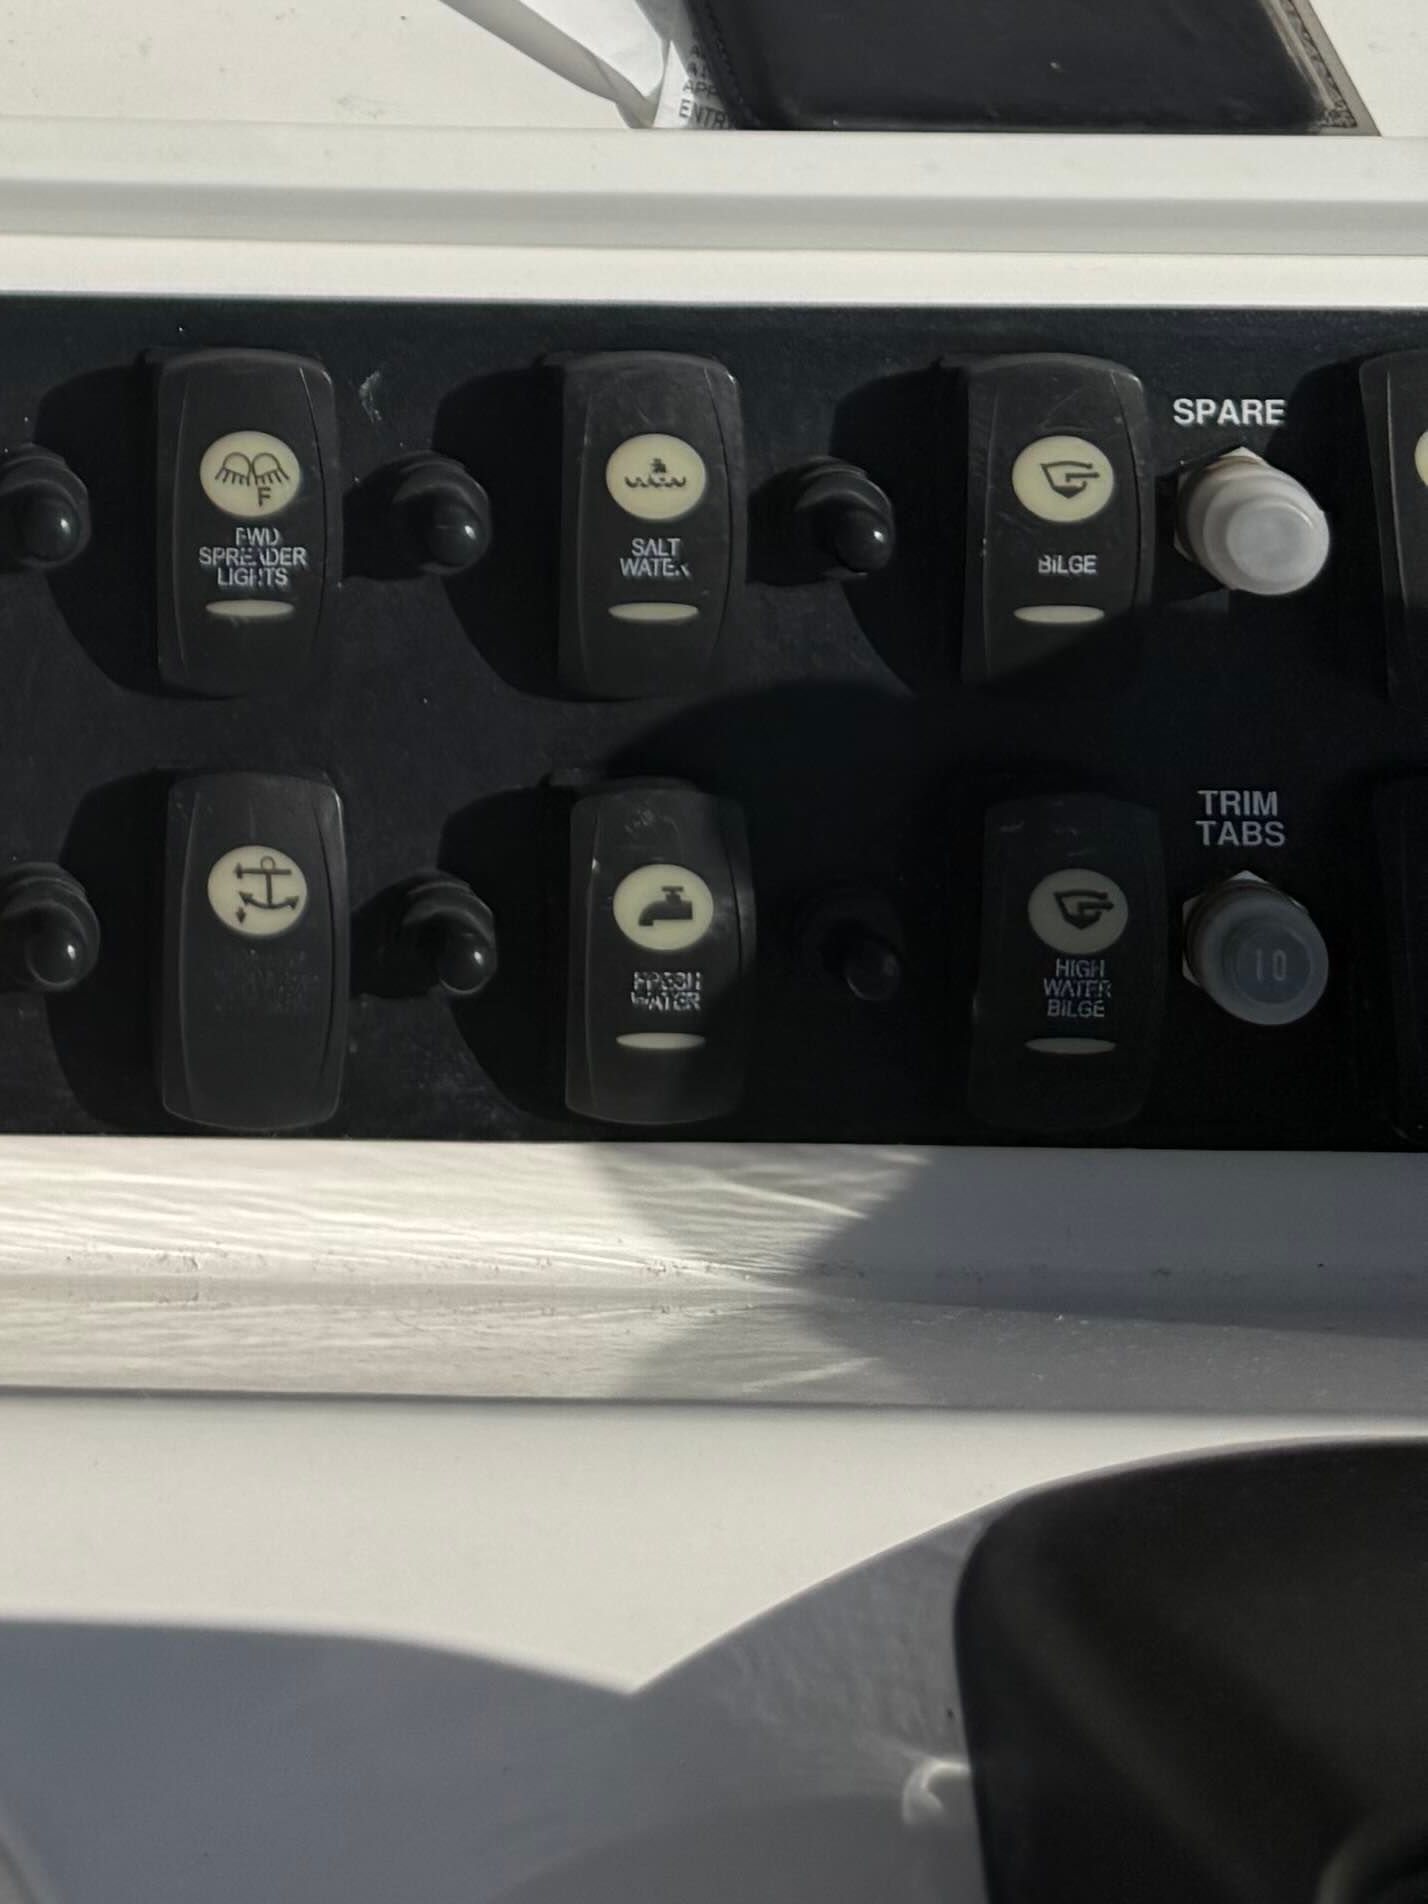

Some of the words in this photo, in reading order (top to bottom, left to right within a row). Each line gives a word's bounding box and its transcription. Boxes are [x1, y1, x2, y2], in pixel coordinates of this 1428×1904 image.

[679, 97, 732, 129] ENTR
[1172, 398, 1288, 428] SPARE
[235, 527, 282, 546] FWD
[631, 537, 681, 557] SALT
[198, 546, 308, 566] SPREADER
[1037, 554, 1098, 576] BILGE
[217, 567, 289, 587] LIGHTS
[619, 557, 692, 577] WATER
[1195, 789, 1279, 817] TRIM
[1195, 820, 1287, 848] TABS
[1055, 958, 1106, 979] HIGH
[1256, 948, 1287, 982] 10
[1042, 978, 1113, 999] WATER
[1046, 1000, 1106, 1019] BILGE
